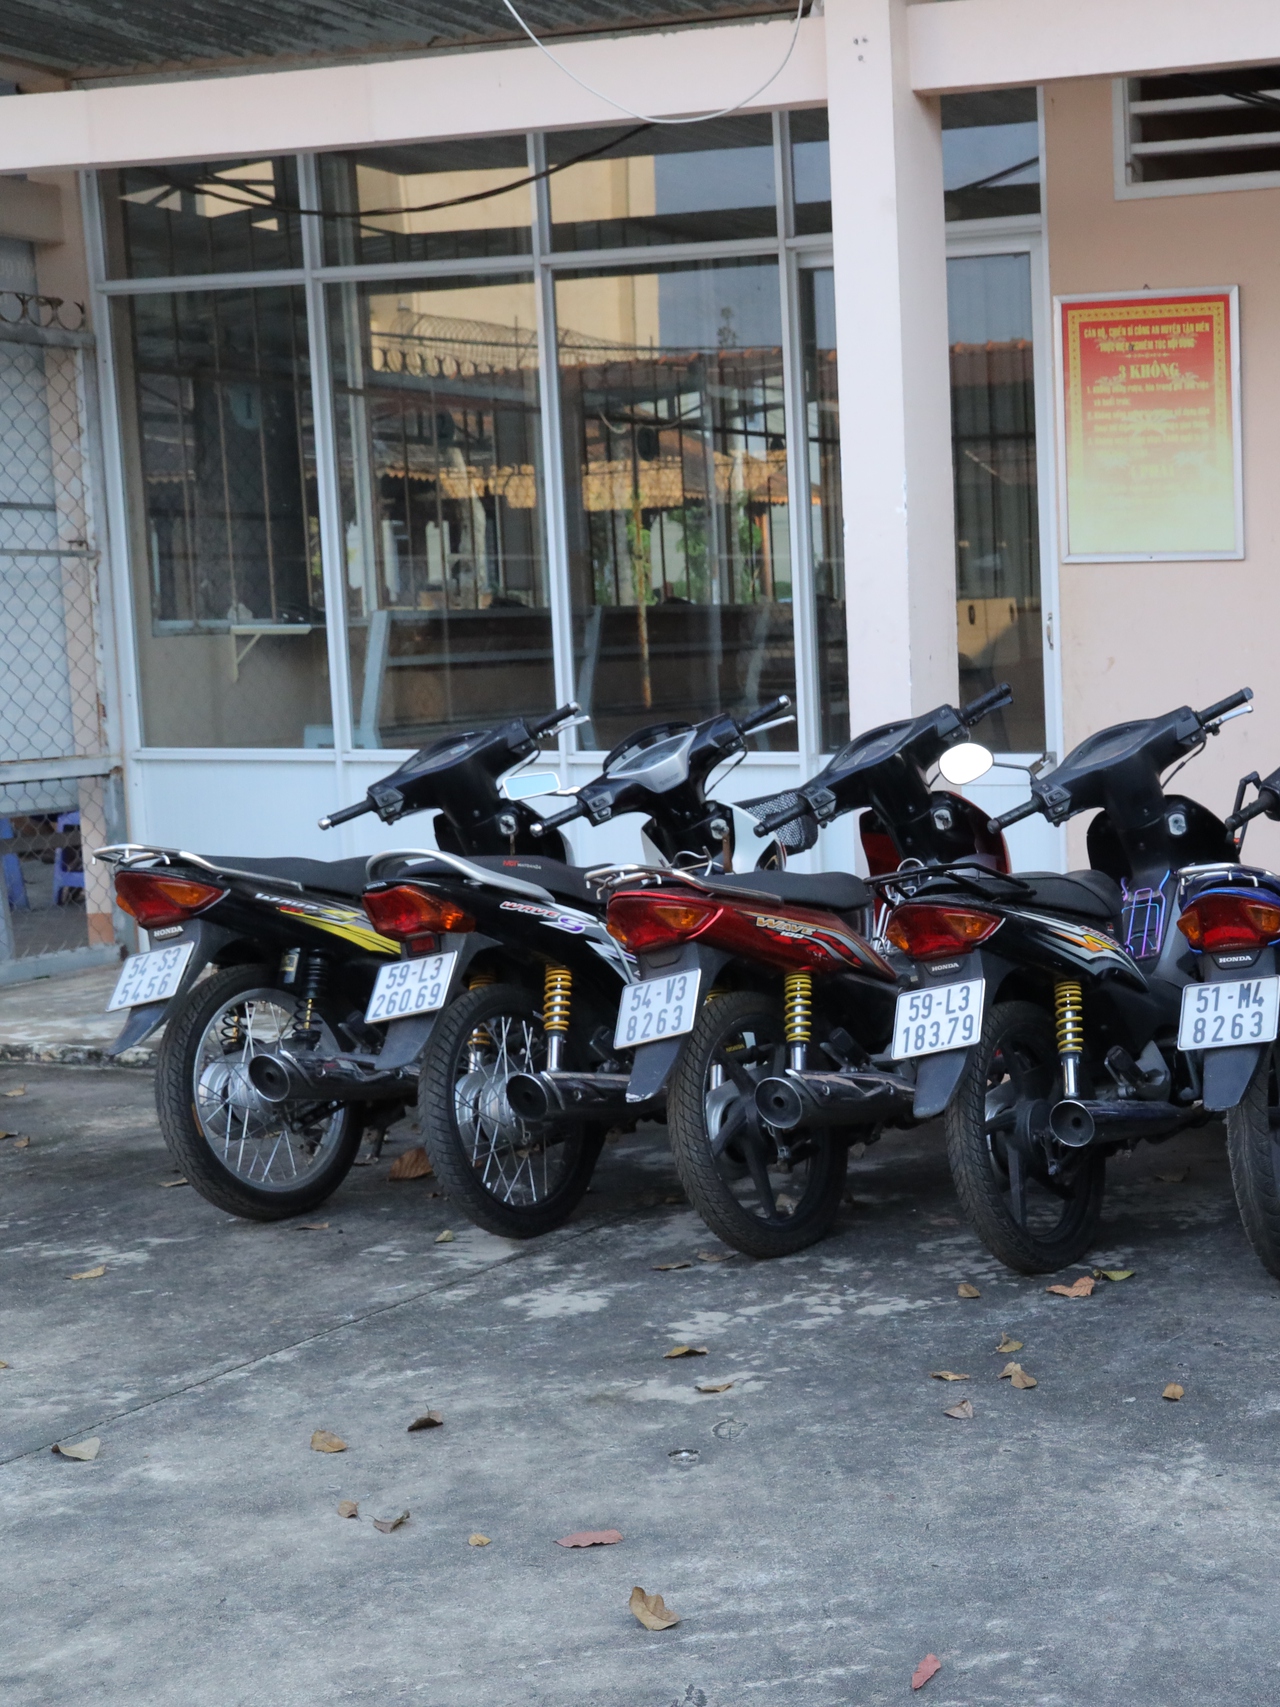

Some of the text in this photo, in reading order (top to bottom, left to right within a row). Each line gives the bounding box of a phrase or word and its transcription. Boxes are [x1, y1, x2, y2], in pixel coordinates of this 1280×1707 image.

[1119, 360, 1180, 379] 3 KHÔNG
[500, 900, 561, 919] WAVE
[153, 925, 184, 938] HONDA
[780, 931, 805, 939] 100
[128, 947, 183, 979] 54-S3
[386, 957, 443, 991] 59-L3
[932, 962, 960, 972] HONDA
[1219, 955, 1252, 964] HONDA
[118, 973, 172, 1006] 5456
[371, 982, 442, 1019] 260.69
[630, 976, 688, 1012] 54-V3
[908, 985, 971, 1022] 59-L3
[1196, 981, 1265, 1014] 51-M4
[626, 1005, 683, 1042] 8263
[902, 1014, 974, 1054] 183.79
[1193, 1011, 1264, 1044] 8263
